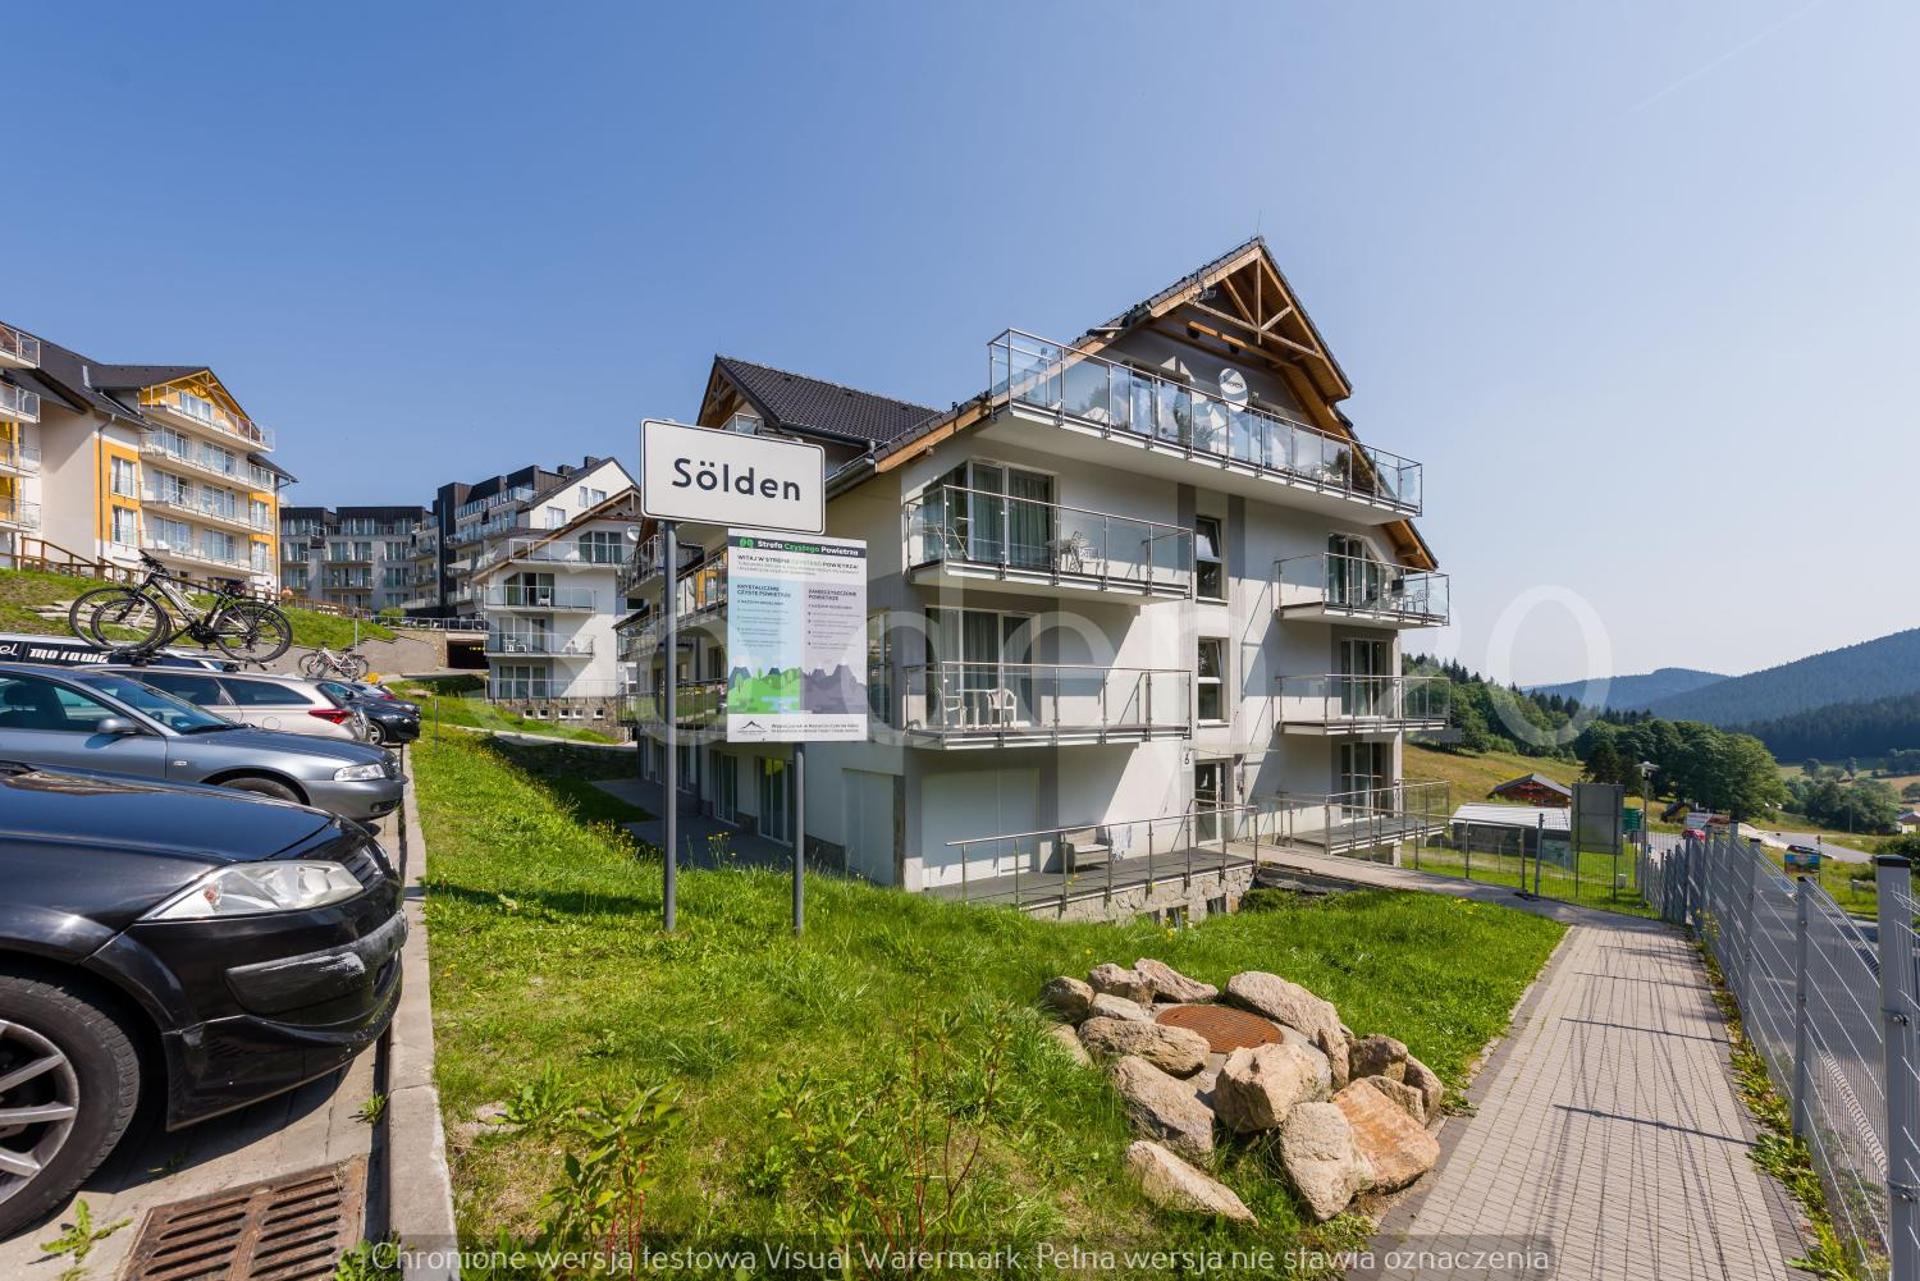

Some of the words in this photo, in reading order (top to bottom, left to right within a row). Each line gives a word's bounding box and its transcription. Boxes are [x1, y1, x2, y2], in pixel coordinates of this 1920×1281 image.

[671, 457, 800, 501] Sölden
[757, 540, 783, 549] Strefa
[821, 547, 859, 556] Powietrza
